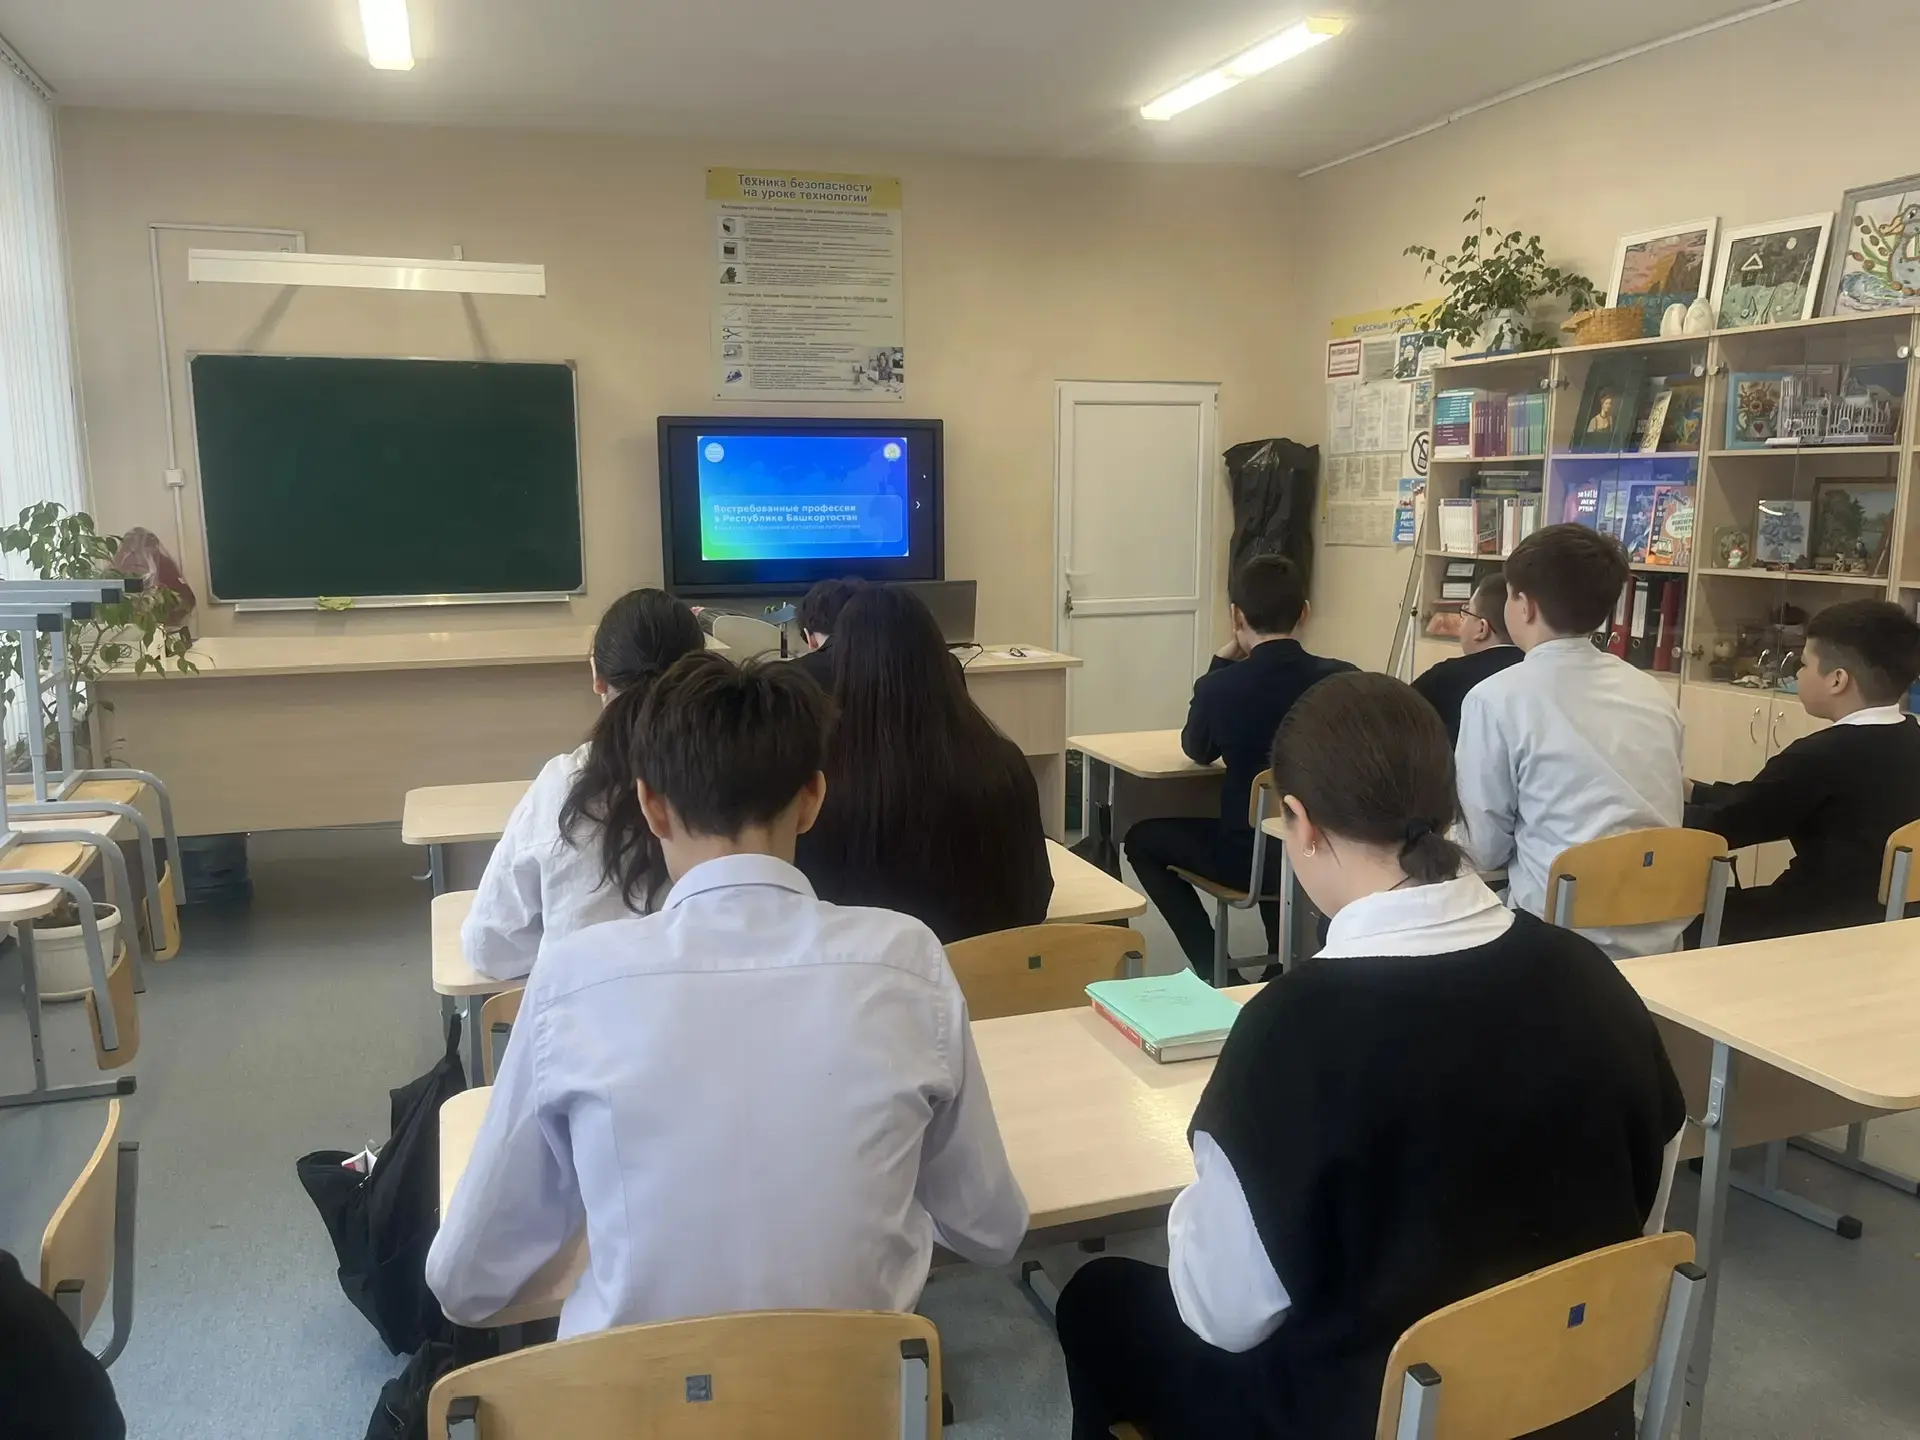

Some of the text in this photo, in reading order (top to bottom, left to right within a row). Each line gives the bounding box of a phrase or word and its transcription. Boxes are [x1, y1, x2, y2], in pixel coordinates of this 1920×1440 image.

[738, 174, 872, 193] Техника безопасности
[743, 188, 868, 203] на уроке технологии
[714, 503, 857, 514] Востребованные профессии
[723, 513, 784, 524] Республике
[786, 512, 858, 523] Башкортостан
